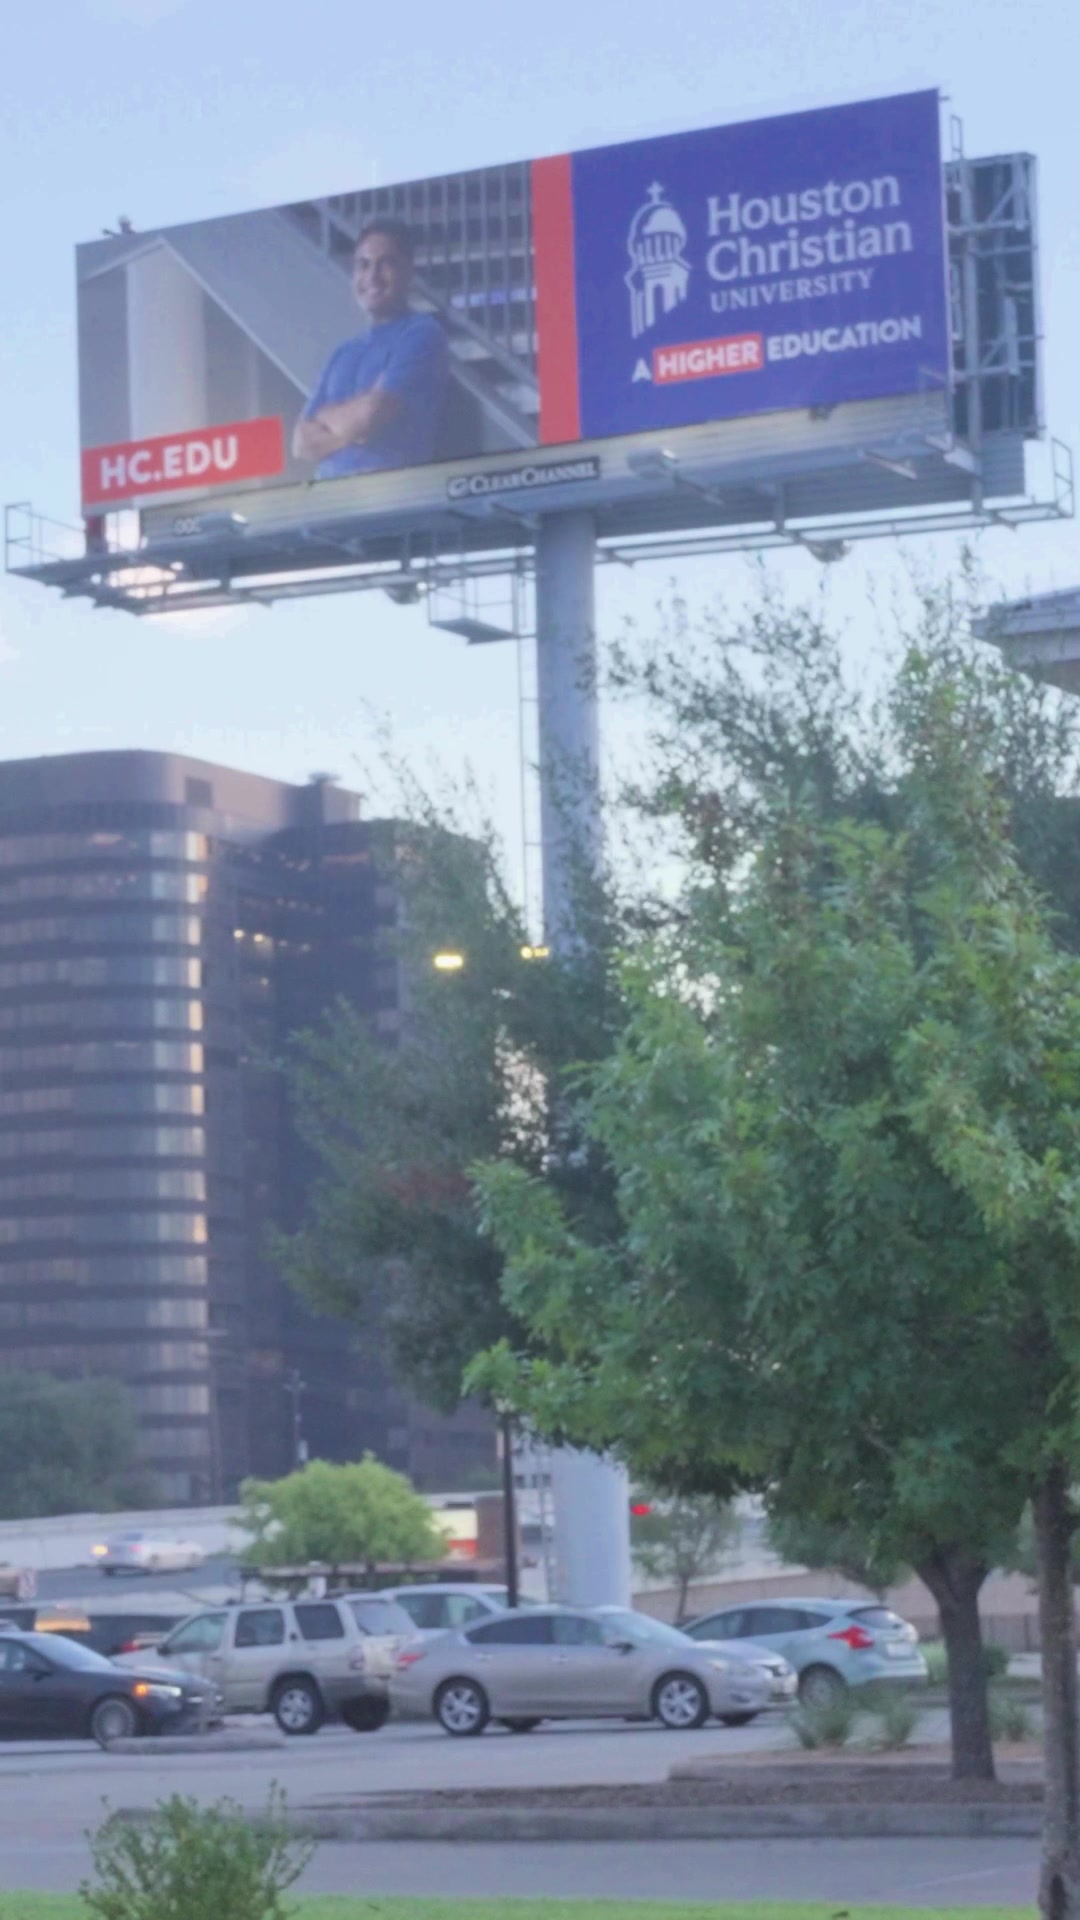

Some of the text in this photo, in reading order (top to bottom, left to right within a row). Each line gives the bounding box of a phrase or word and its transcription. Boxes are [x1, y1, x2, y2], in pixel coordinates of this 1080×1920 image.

[707, 175, 900, 236] Houston
[706, 219, 913, 281] Christian
[710, 268, 874, 312] UNIVERSITY
[631, 316, 922, 382] A HIGHER EDUCATION
[101, 435, 238, 489] HC.EDU
